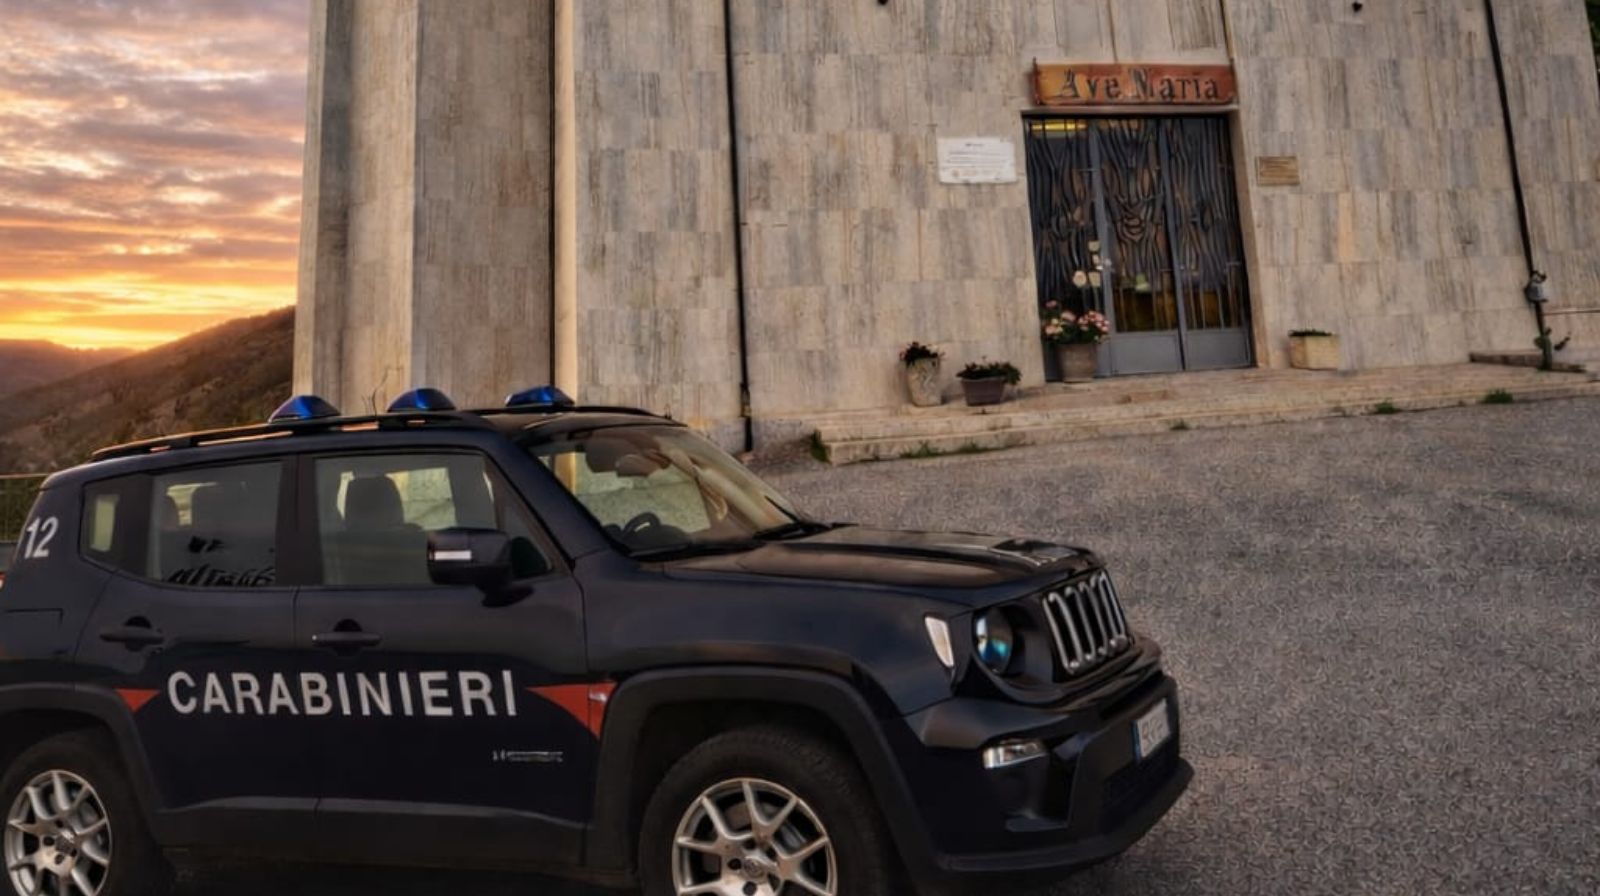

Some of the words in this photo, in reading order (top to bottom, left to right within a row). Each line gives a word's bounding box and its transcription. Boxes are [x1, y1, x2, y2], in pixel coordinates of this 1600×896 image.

[1057, 68, 1120, 99] Ave
[24, 516, 59, 559] 12
[167, 669, 518, 718] CARABINIERI
